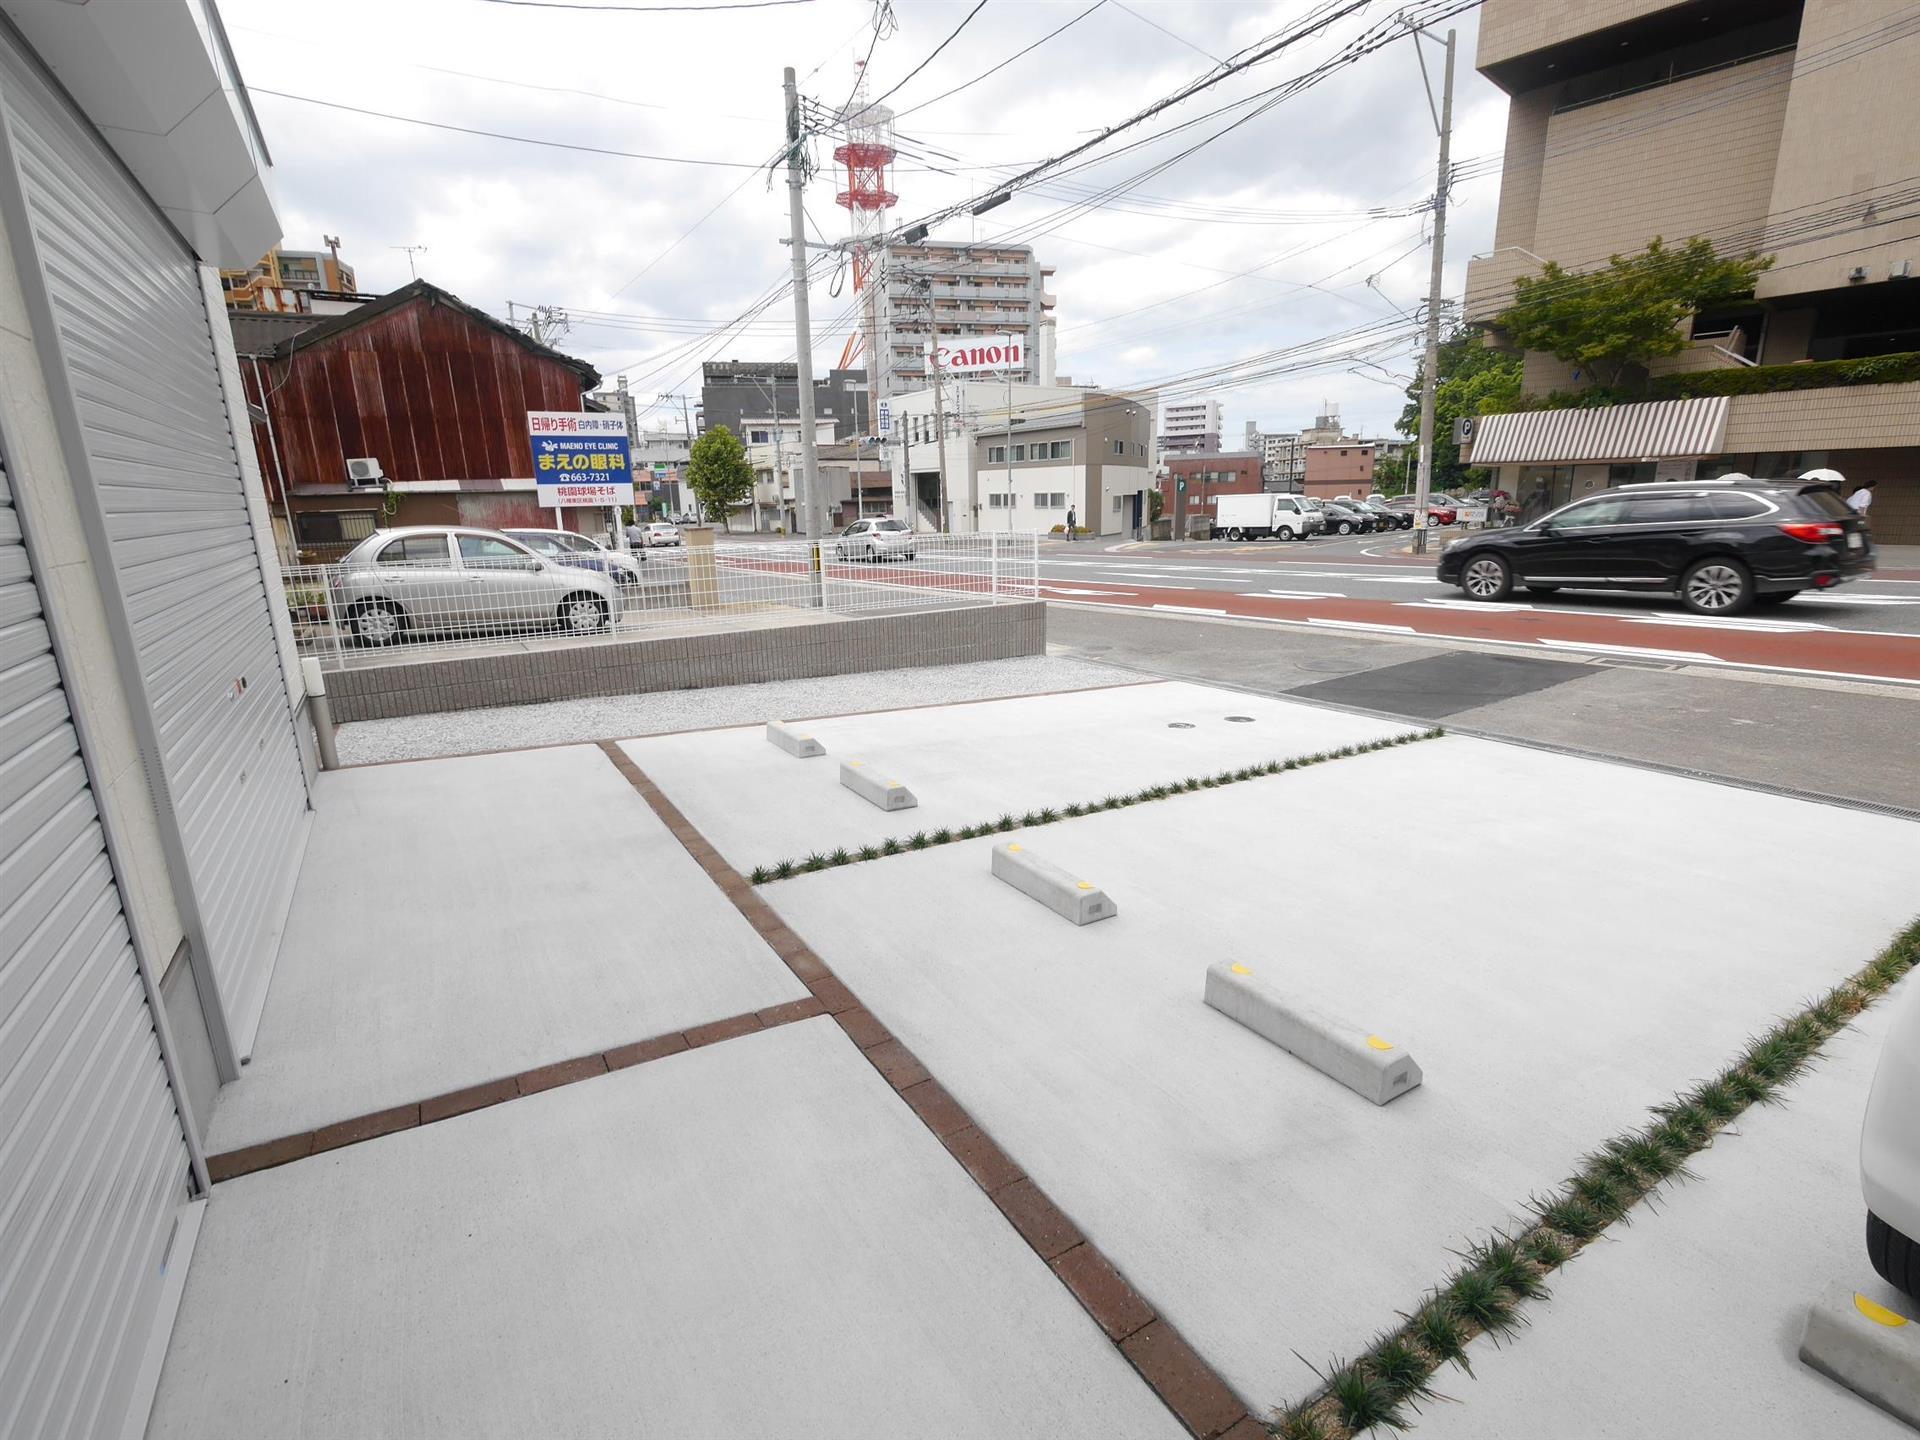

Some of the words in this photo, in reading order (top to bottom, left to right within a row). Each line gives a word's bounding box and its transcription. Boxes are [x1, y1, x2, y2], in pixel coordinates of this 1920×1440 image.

[930, 344, 1019, 367] Canon
[532, 417, 577, 432] 日帰り手術
[560, 442, 584, 450] MAENO
[585, 442, 597, 450] EYE
[598, 442, 619, 450] CLINIC
[538, 453, 625, 470] まえの眼科
